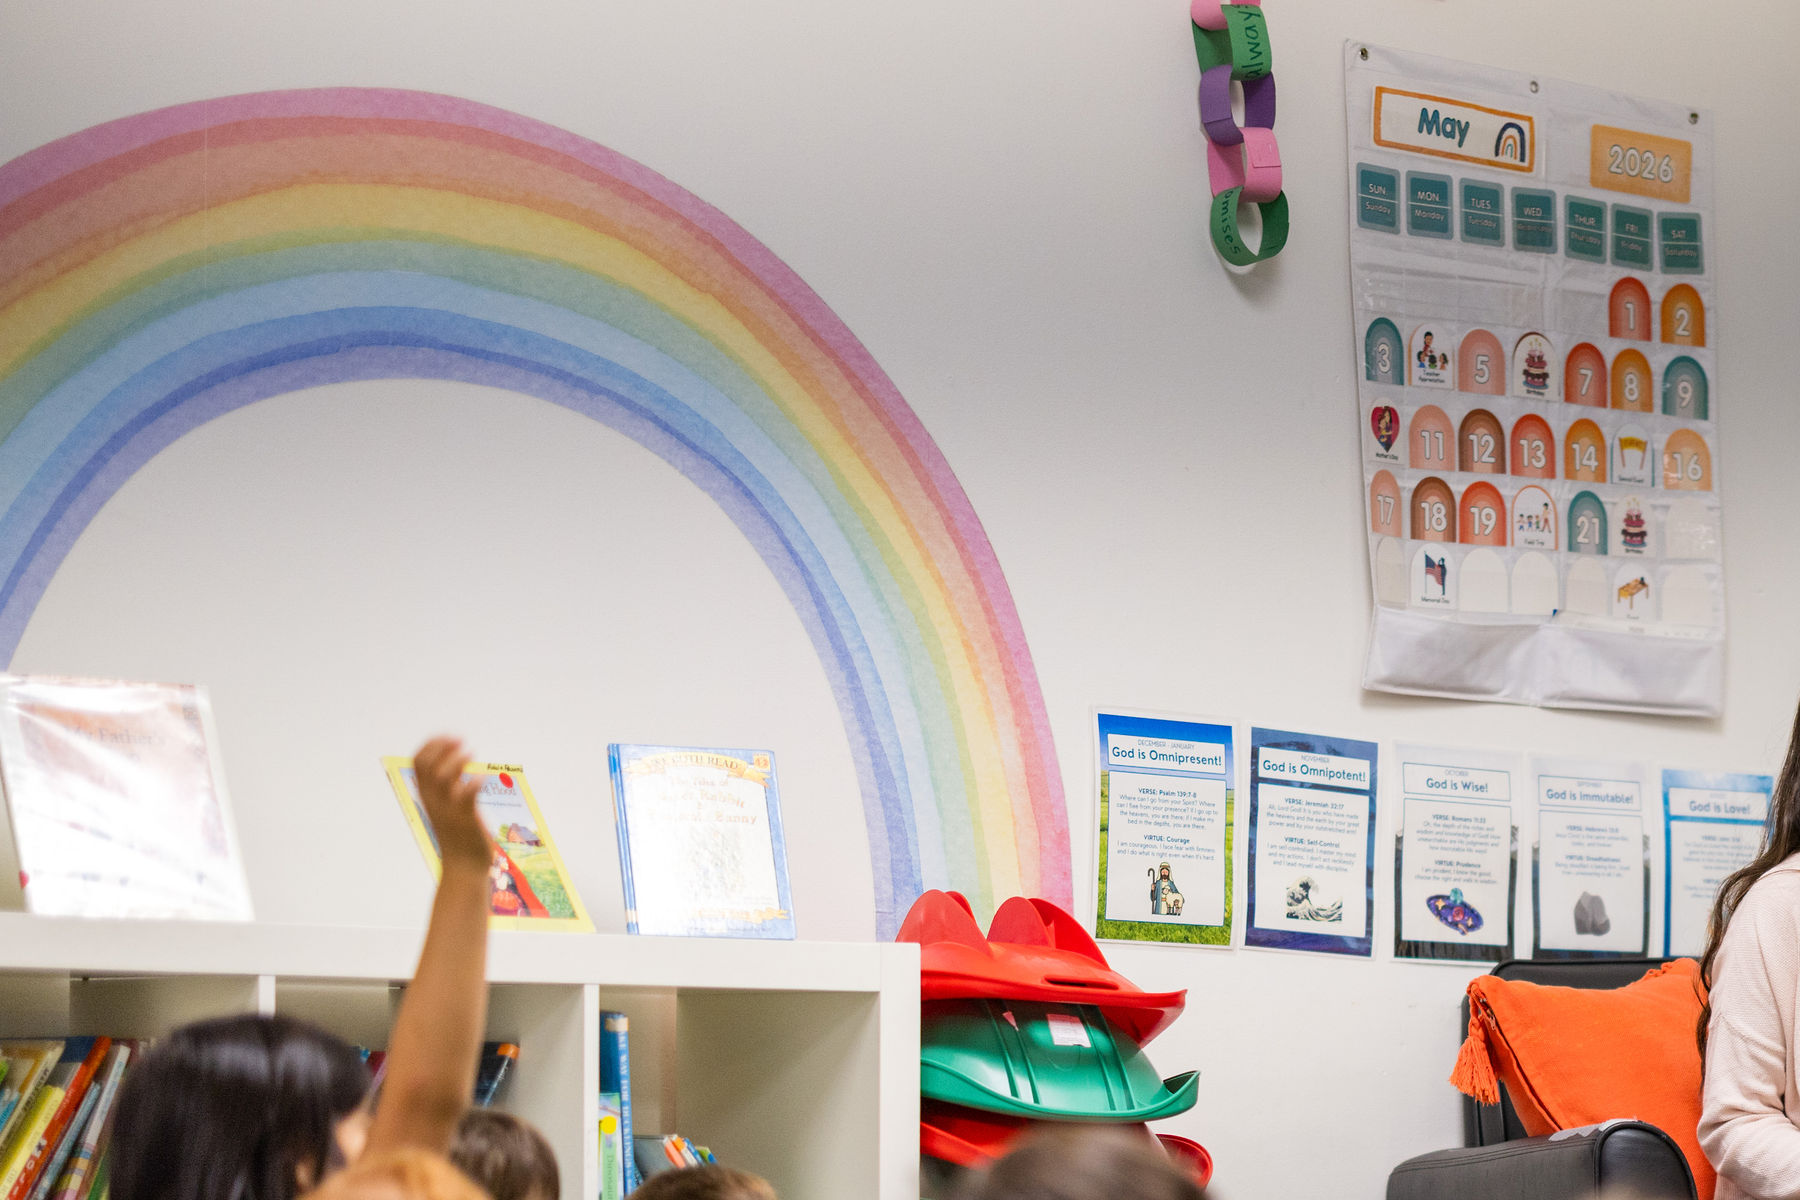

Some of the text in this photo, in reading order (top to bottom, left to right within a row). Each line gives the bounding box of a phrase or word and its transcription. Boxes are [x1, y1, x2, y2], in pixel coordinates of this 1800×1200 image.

[1417, 107, 1470, 148] May
[1609, 144, 1674, 183] 2026
[1368, 183, 1387, 196] SUN
[1417, 190, 1440, 202] MON
[1471, 197, 1492, 210] TUES
[1523, 206, 1543, 217] WED
[1625, 302, 1636, 331] 1
[1674, 308, 1690, 337] 2
[1377, 343, 1391, 374] 3
[1474, 355, 1490, 384] 5
[1579, 368, 1594, 396] 7
[1624, 374, 1639, 402] 8
[1677, 380, 1693, 408] 9
[1420, 430, 1446, 461] 11
[1468, 434, 1496, 463] 12
[1519, 438, 1546, 469] 13
[1571, 442, 1599, 472] 14
[1672, 452, 1703, 482] 16
[1376, 494, 1395, 527] 17
[1420, 501, 1447, 531] 18
[1469, 506, 1497, 536] 19
[1576, 515, 1600, 545] 21
[1112, 746, 1222, 766] God is Omnipresent!
[1262, 759, 1286, 773] God
[1288, 762, 1297, 774] is
[1300, 764, 1366, 782] Omnipotent!
[1426, 777, 1488, 793] God is Wise!
[1546, 788, 1634, 804] God is Immutable!
[1689, 800, 1751, 814] God is Love!
